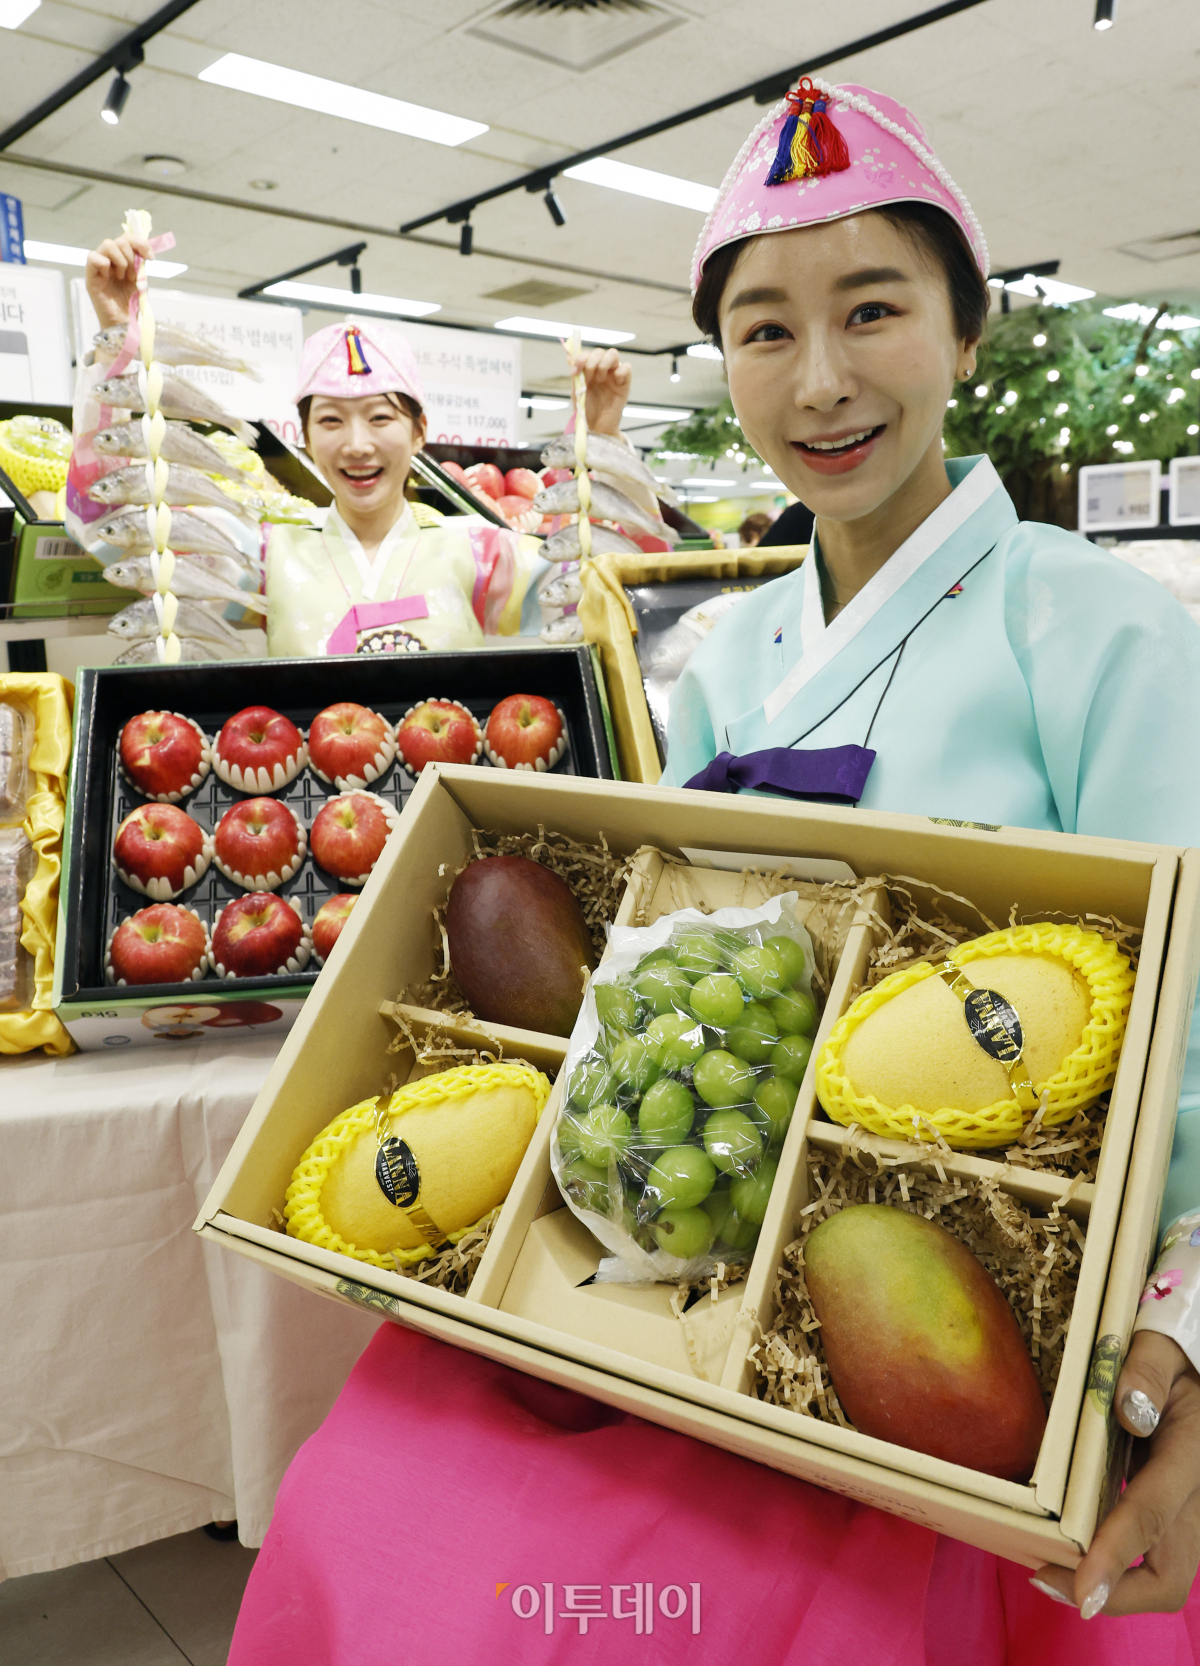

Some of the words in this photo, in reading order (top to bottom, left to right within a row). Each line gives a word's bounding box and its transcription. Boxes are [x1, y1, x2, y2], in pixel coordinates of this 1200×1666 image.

[229, 325, 294, 350] 특별혜택
[464, 354, 513, 376] 특별혜택
[970, 990, 1021, 1058] LANNA
[381, 1161, 395, 1192] HARVEST
[382, 1140, 413, 1206] LANNA
